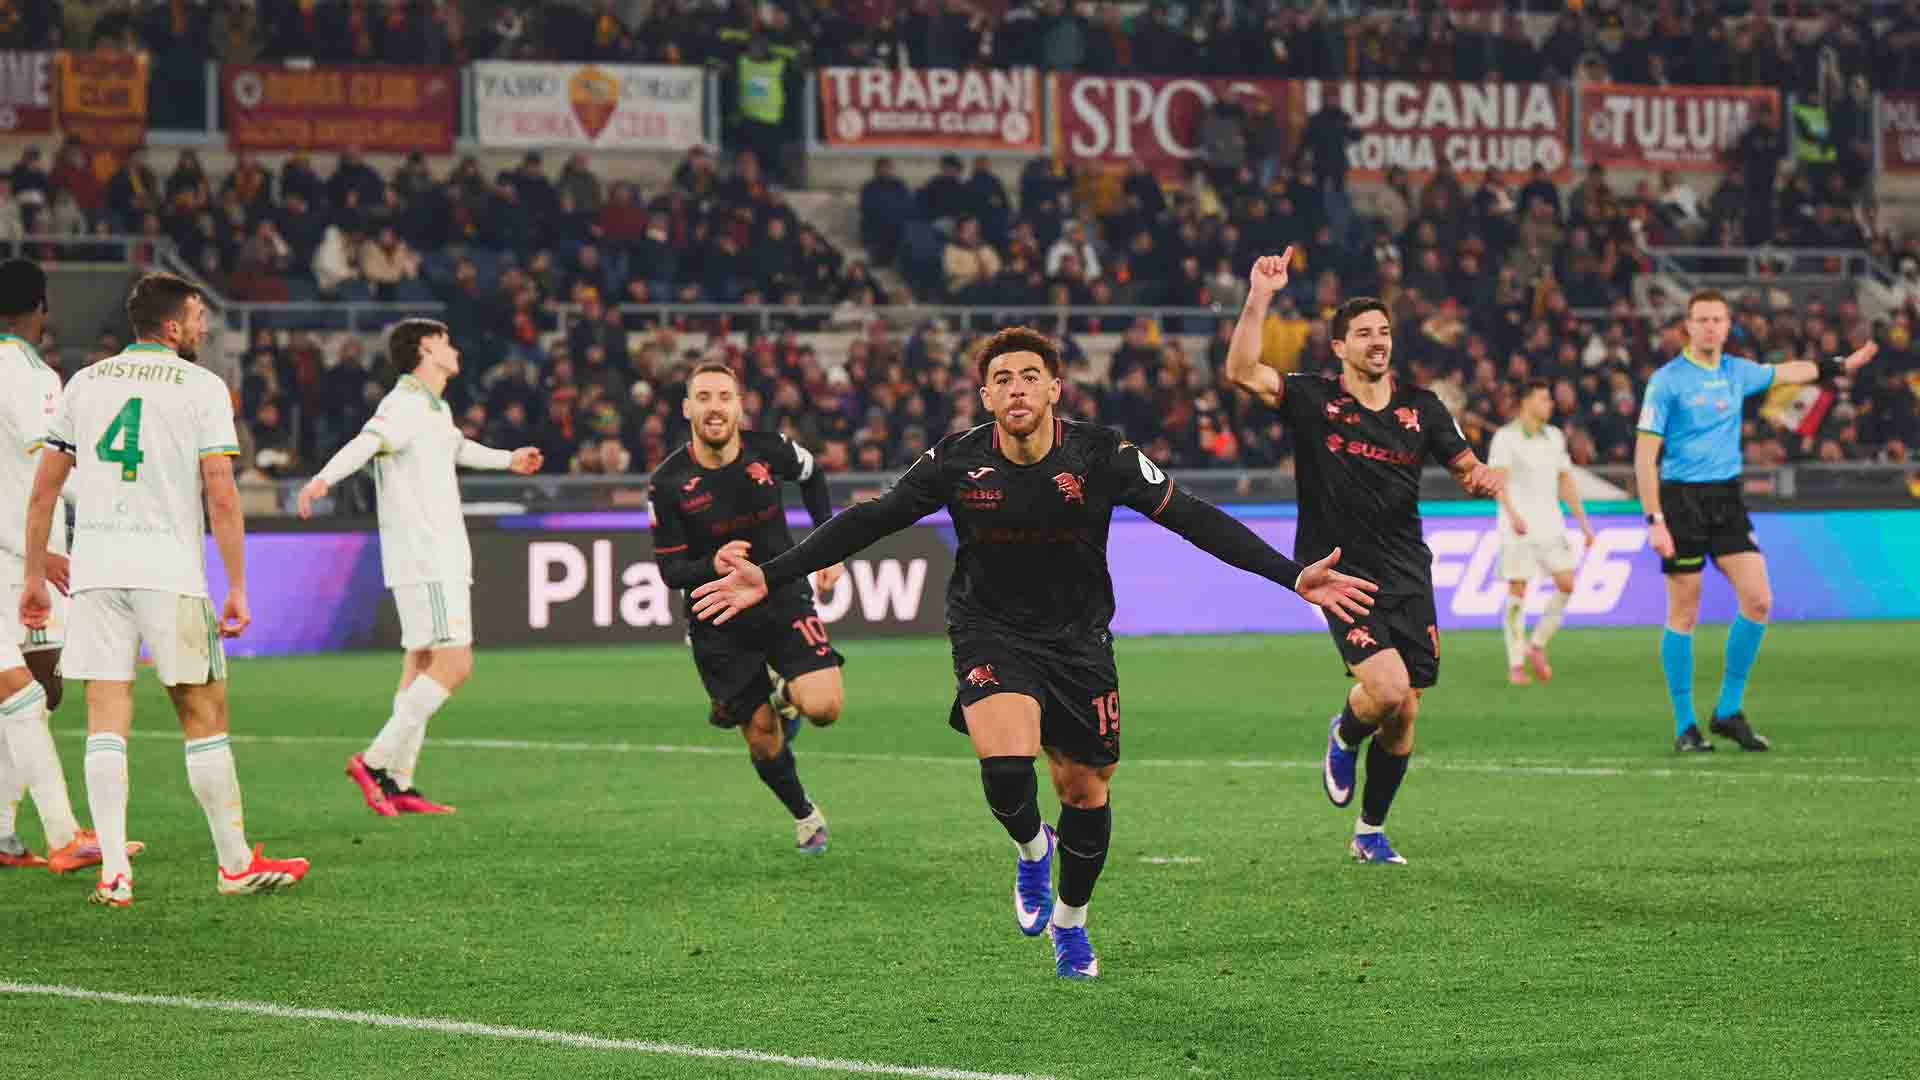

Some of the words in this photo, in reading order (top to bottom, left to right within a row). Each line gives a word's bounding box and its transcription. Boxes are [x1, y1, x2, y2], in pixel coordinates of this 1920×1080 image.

[827, 66, 1037, 110] TRAPANI
[95, 397, 144, 482] 4
[528, 539, 672, 628] Pla
[807, 556, 927, 623] ow
[792, 615, 828, 647] 10
[1091, 690, 1120, 737] 19
